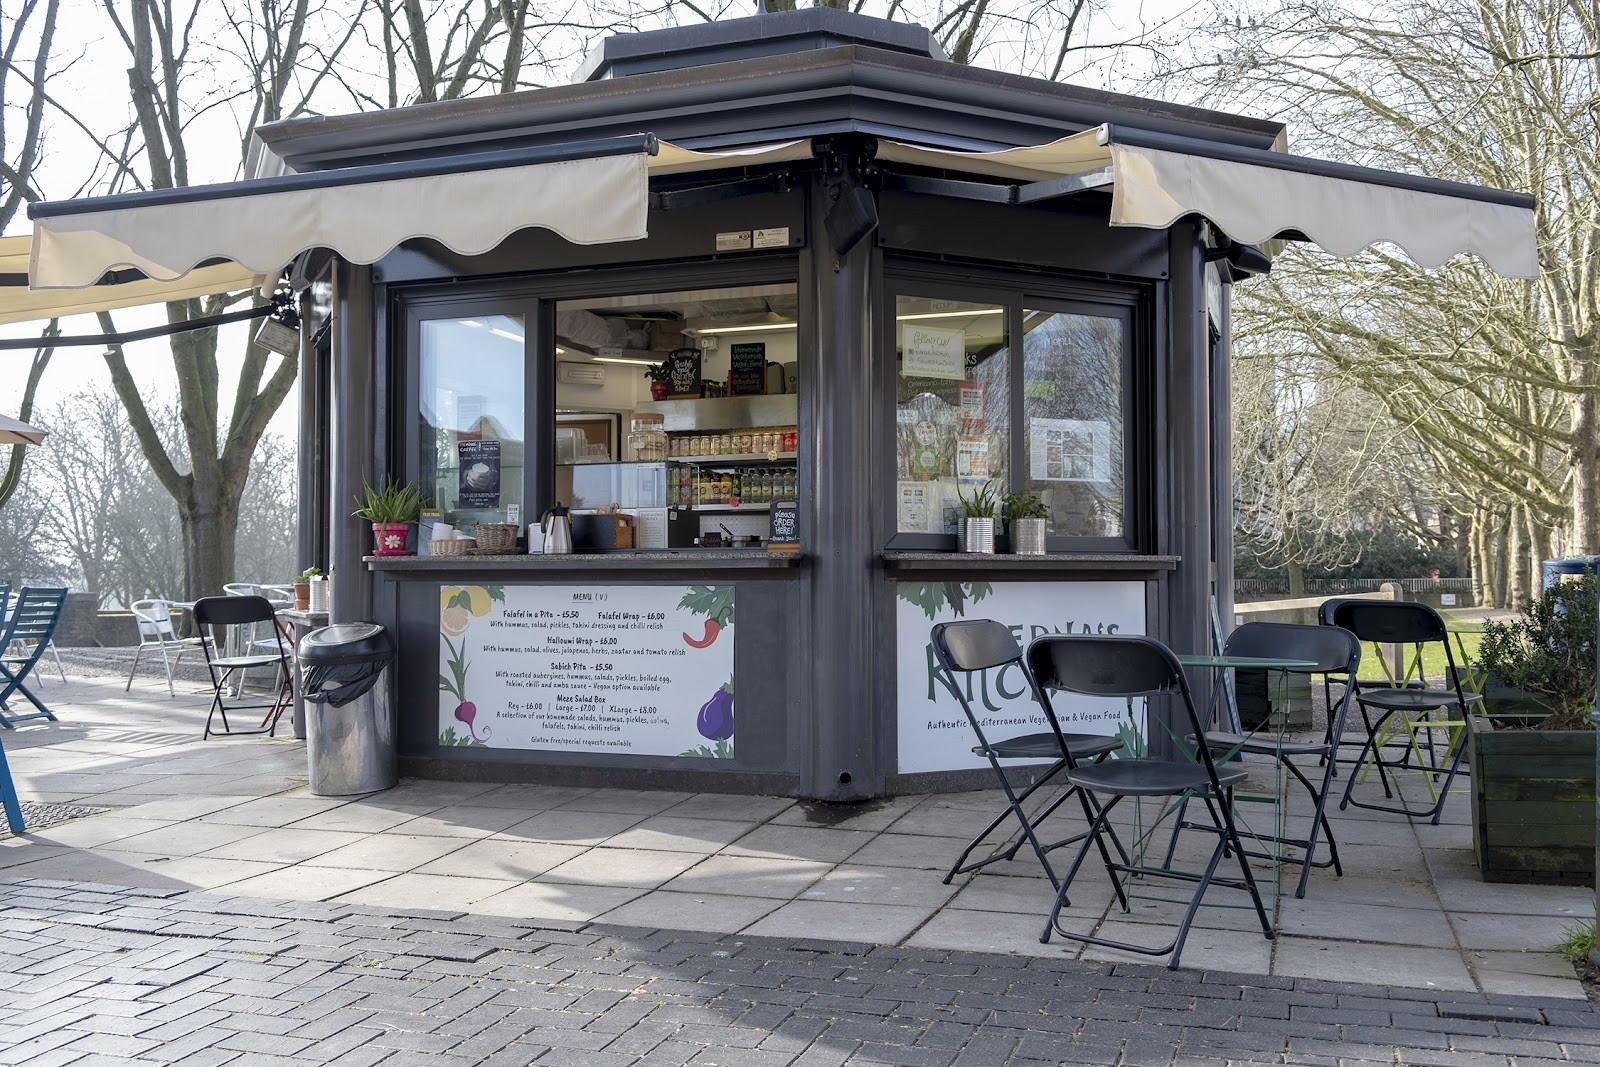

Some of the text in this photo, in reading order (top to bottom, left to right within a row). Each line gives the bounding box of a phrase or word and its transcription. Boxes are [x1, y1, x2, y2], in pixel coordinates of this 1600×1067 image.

[572, 593, 592, 601] MENU
[503, 609, 525, 618] Falafel
[526, 610, 533, 618] in
[540, 610, 554, 618] Pita
[562, 610, 580, 618] £5.50
[598, 611, 621, 620] Falafel
[622, 613, 640, 621] Wrap
[647, 612, 665, 620] £6.00
[504, 621, 530, 629] hummus,
[531, 621, 549, 629] salad,
[550, 621, 571, 630] pickles,
[572, 621, 590, 629] tahini
[591, 622, 616, 630] dressing
[630, 622, 645, 630] chilli
[646, 622, 664, 630] relish
[547, 636, 575, 645] Halloumi
[576, 637, 593, 646] Wrap
[600, 637, 618, 645] £6.00
[497, 645, 523, 653] hummus,
[523, 646, 542, 654] salad,
[542, 646, 561, 654] olives,
[591, 647, 610, 655] herbs,
[646, 648, 668, 656] tomato
[668, 648, 686, 656] relish
[550, 662, 571, 671] Sabich
[573, 662, 587, 671] Pita
[595, 663, 613, 671] £5.50
[510, 671, 532, 679] roasted
[533, 672, 566, 680] aubergines,
[566, 672, 593, 680] hummus,
[594, 673, 615, 681] salads,
[616, 674, 638, 682] pickles,
[639, 674, 658, 682] boiled
[658, 676, 672, 684] egg,
[505, 680, 525, 688] tahini,
[553, 681, 569, 689] amba
[593, 682, 611, 691] Vegan
[612, 683, 631, 691] option
[632, 683, 660, 691] available
[557, 694, 607, 703] Meze Salad Box
[508, 701, 519, 711] Reg
[526, 702, 543, 710] £6.00
[555, 703, 573, 713] Large
[580, 704, 596, 712] £7.00
[609, 705, 632, 715] XLarge
[639, 706, 657, 714] £8.00
[501, 711, 527, 719] selection
[546, 713, 575, 721] homemade
[577, 714, 598, 722] salads,
[598, 715, 625, 723] hummus,
[626, 716, 649, 724] pickles,
[927, 720, 967, 730] Authentic
[1029, 714, 1070, 725] Vegeian
[1072, 712, 1078, 721] &
[1080, 712, 1101, 722] Vegan
[1103, 710, 1121, 719] Food
[542, 722, 566, 730] falafels,
[567, 722, 587, 731] tahini,
[587, 723, 603, 731] chilli
[531, 735, 549, 743] Gluten
[550, 736, 581, 745] free/special
[606, 739, 632, 747] available
